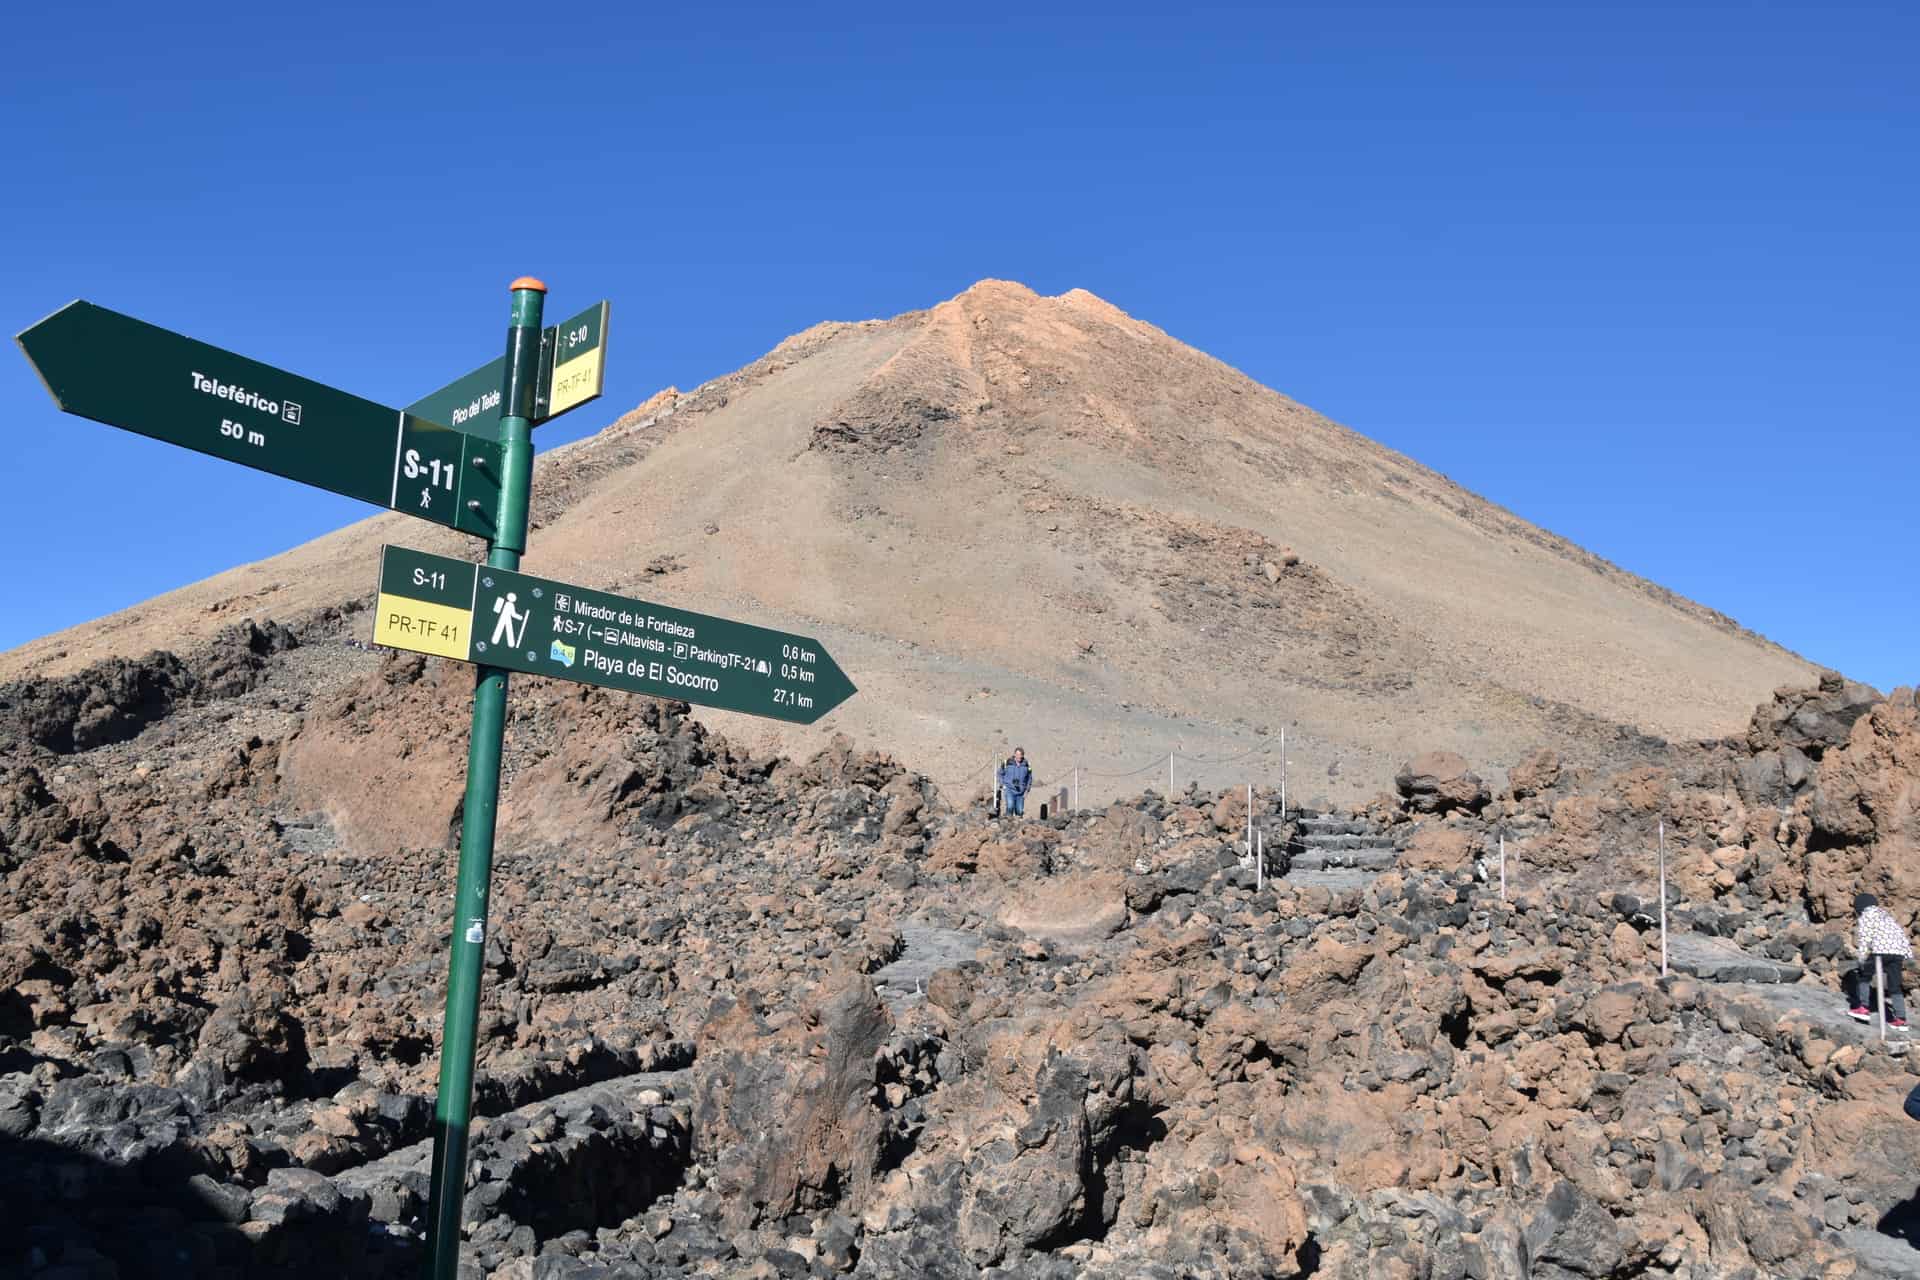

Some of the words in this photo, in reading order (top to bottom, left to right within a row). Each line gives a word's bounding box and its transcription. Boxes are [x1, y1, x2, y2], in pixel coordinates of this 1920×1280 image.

[569, 325, 588, 348] S-10
[191, 371, 279, 415] Teleférico
[452, 408, 468, 427] Pico
[469, 398, 480, 418] del
[481, 389, 501, 411] Teide
[220, 418, 244, 439] 50
[247, 430, 265, 447] m
[404, 449, 455, 491] S-11
[413, 567, 446, 591] S-11
[389, 613, 437, 637] PR-TF
[440, 625, 458, 642] 41
[574, 600, 617, 621] Mirador
[618, 610, 632, 625] de
[634, 613, 645, 628] la
[647, 616, 695, 639] Fortaleza
[564, 619, 585, 635] S-7
[620, 631, 665, 653] Altavista
[782, 644, 799, 660] 0,6
[800, 648, 816, 664] km
[583, 649, 624, 676] Playa
[627, 658, 645, 677] de
[649, 662, 663, 681] El
[666, 666, 719, 692] Socorro
[781, 663, 798, 680] 0,5
[799, 667, 815, 683] km
[773, 688, 796, 706] 27,1
[797, 693, 813, 709] km
